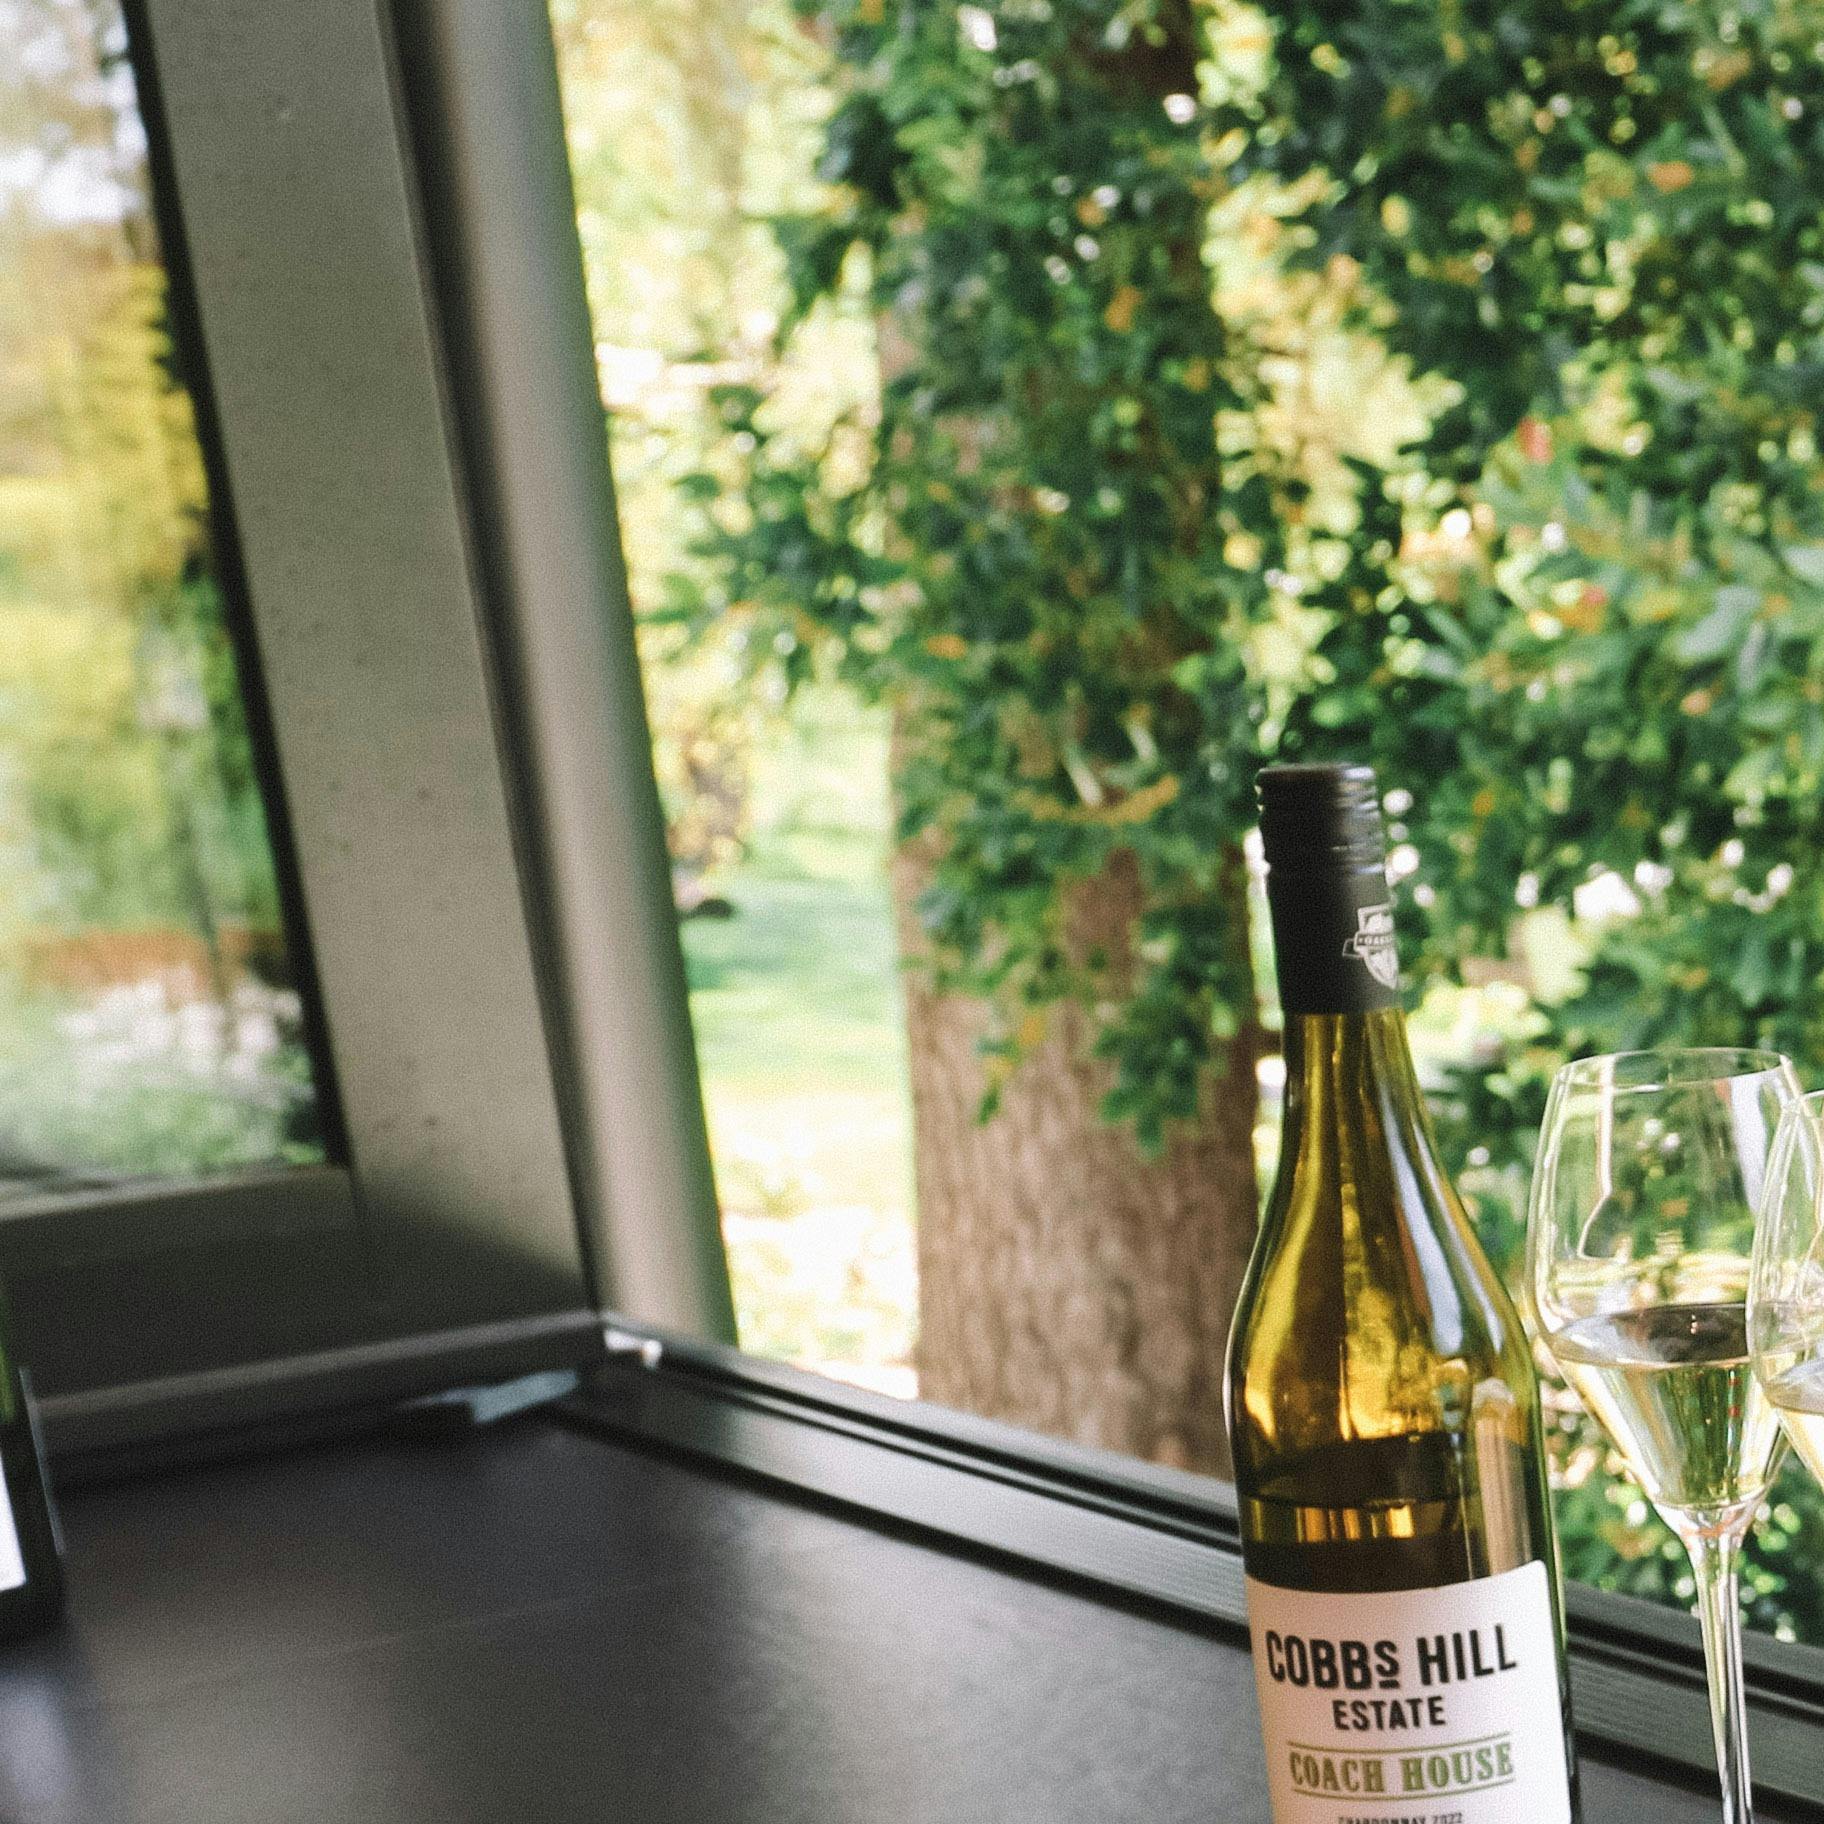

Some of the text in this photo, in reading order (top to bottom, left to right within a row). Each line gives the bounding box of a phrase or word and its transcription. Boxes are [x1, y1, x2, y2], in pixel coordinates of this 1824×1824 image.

[1416, 1623, 1518, 1686] HILL
[1332, 1695, 1446, 1731] ESTATE
[1289, 1741, 1514, 1793] COACH HOUSE
